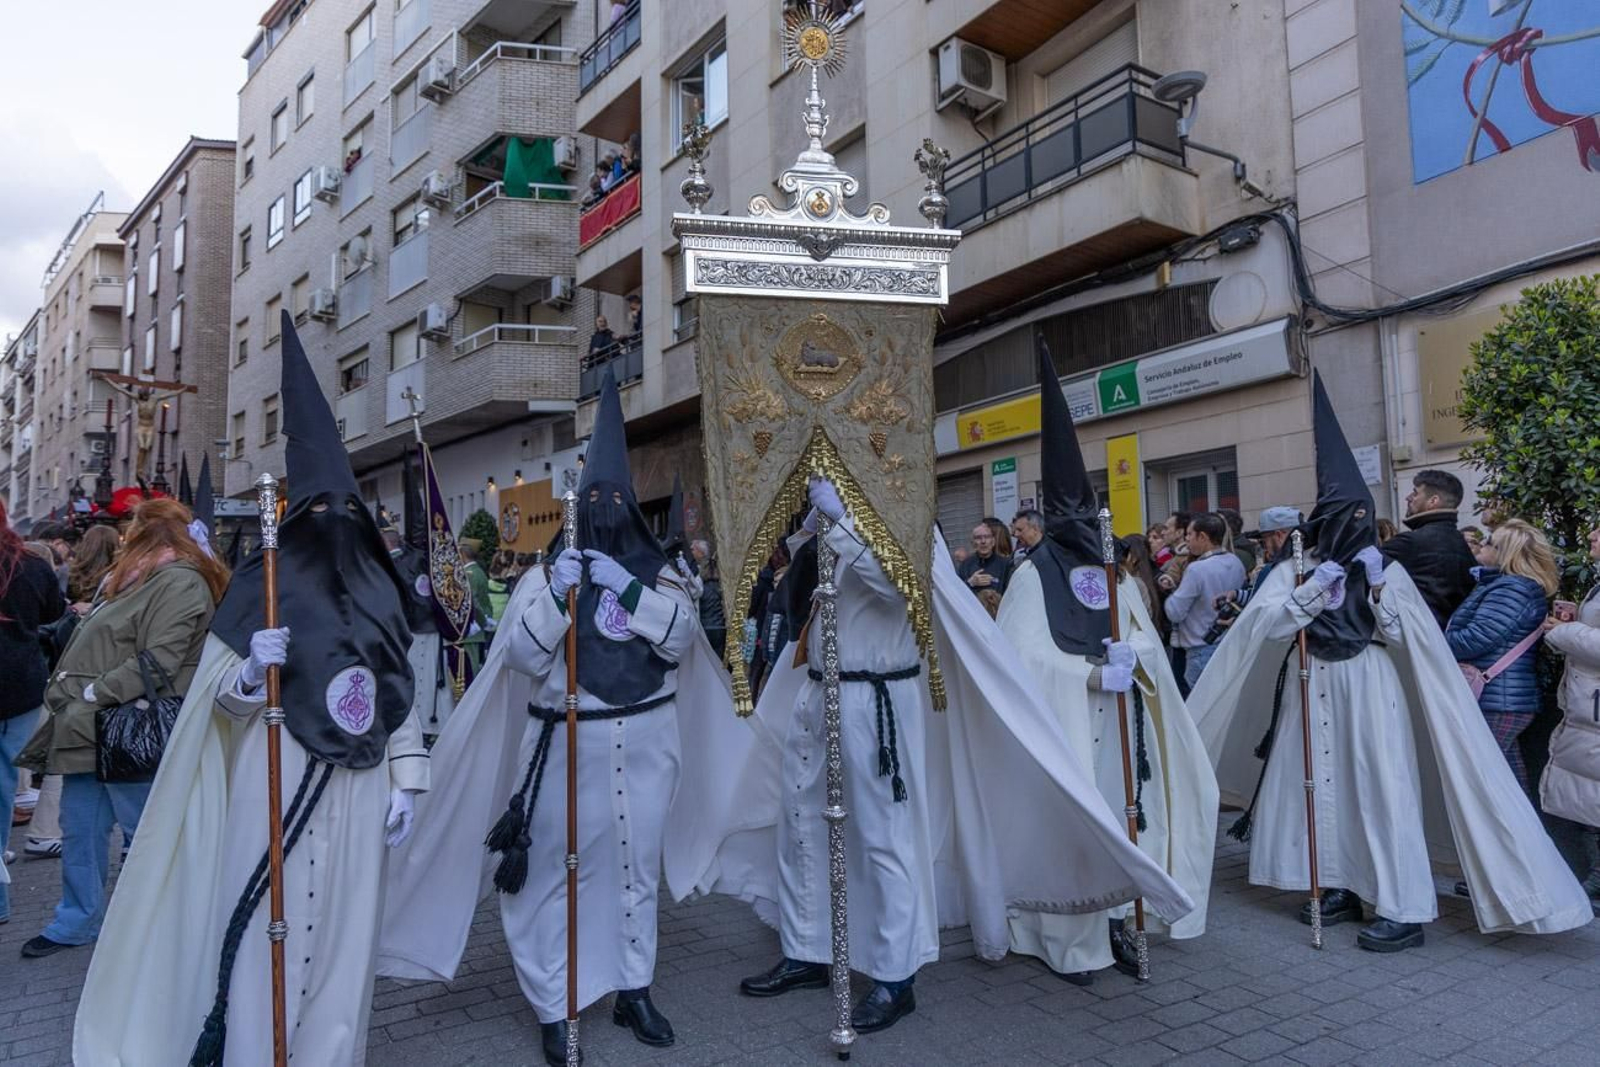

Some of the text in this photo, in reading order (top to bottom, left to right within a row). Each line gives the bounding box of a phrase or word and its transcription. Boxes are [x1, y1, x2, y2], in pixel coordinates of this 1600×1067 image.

[1144, 352, 1243, 383] Servicio Andaluz de Empleo
